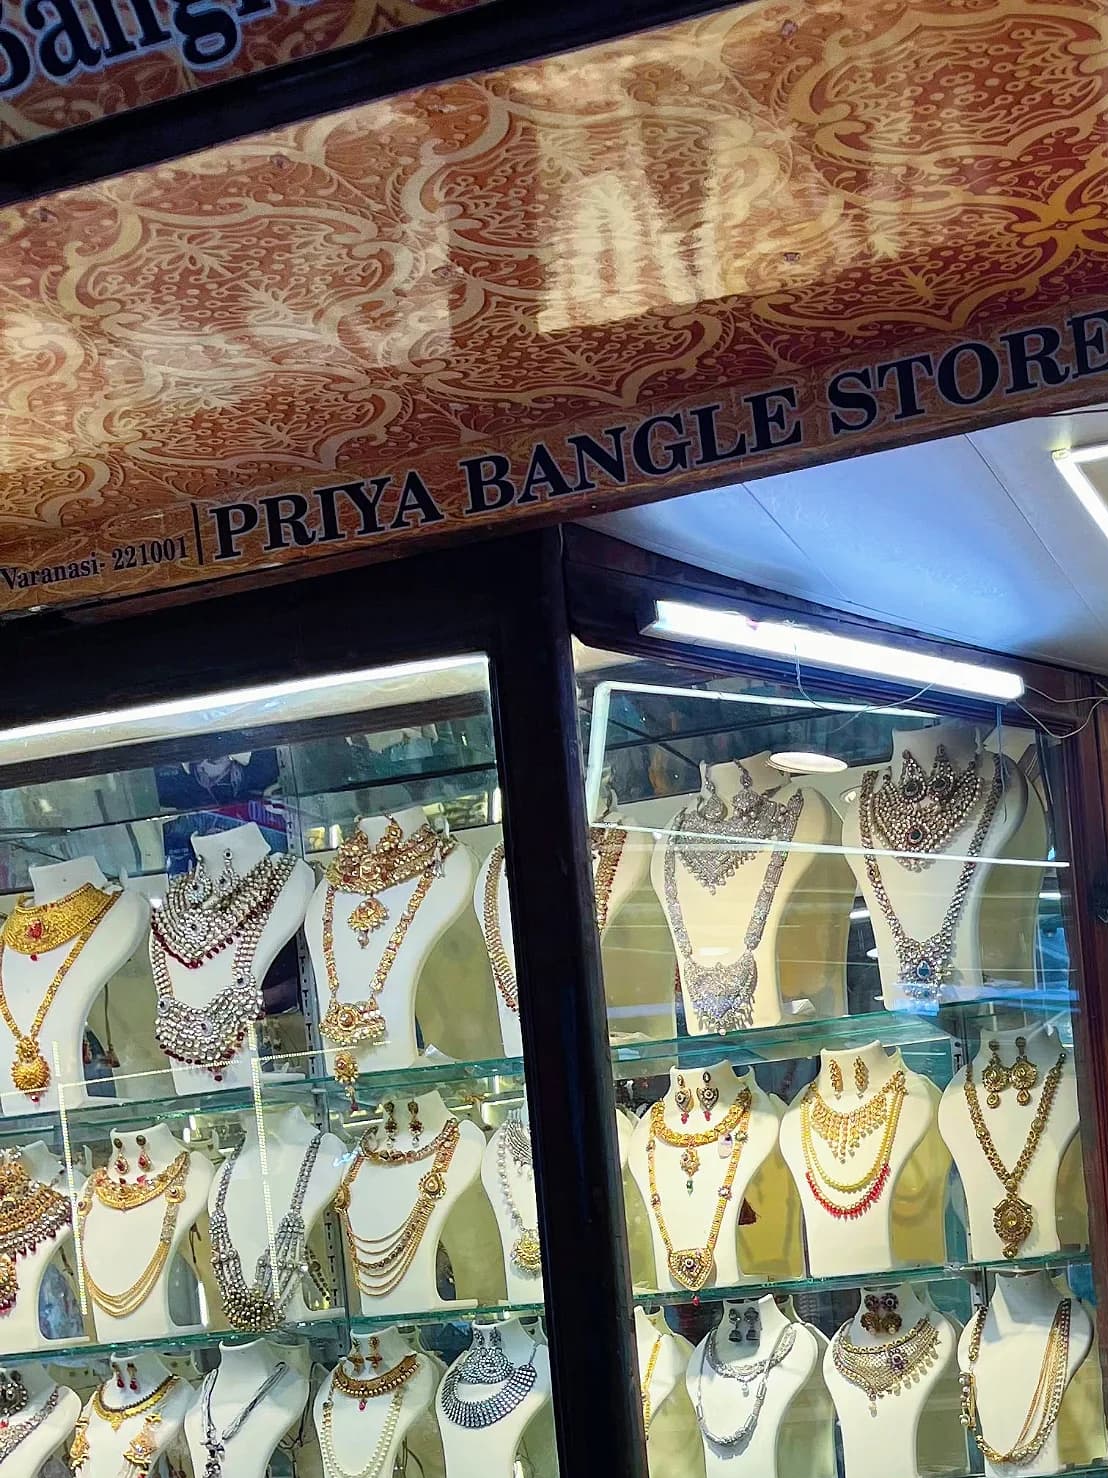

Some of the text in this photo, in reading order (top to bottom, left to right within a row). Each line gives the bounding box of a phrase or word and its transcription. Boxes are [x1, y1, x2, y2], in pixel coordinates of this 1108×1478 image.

[209, 472, 443, 560] PRIYA
[461, 390, 801, 515] BANGLE
[112, 536, 188, 571] 221001
